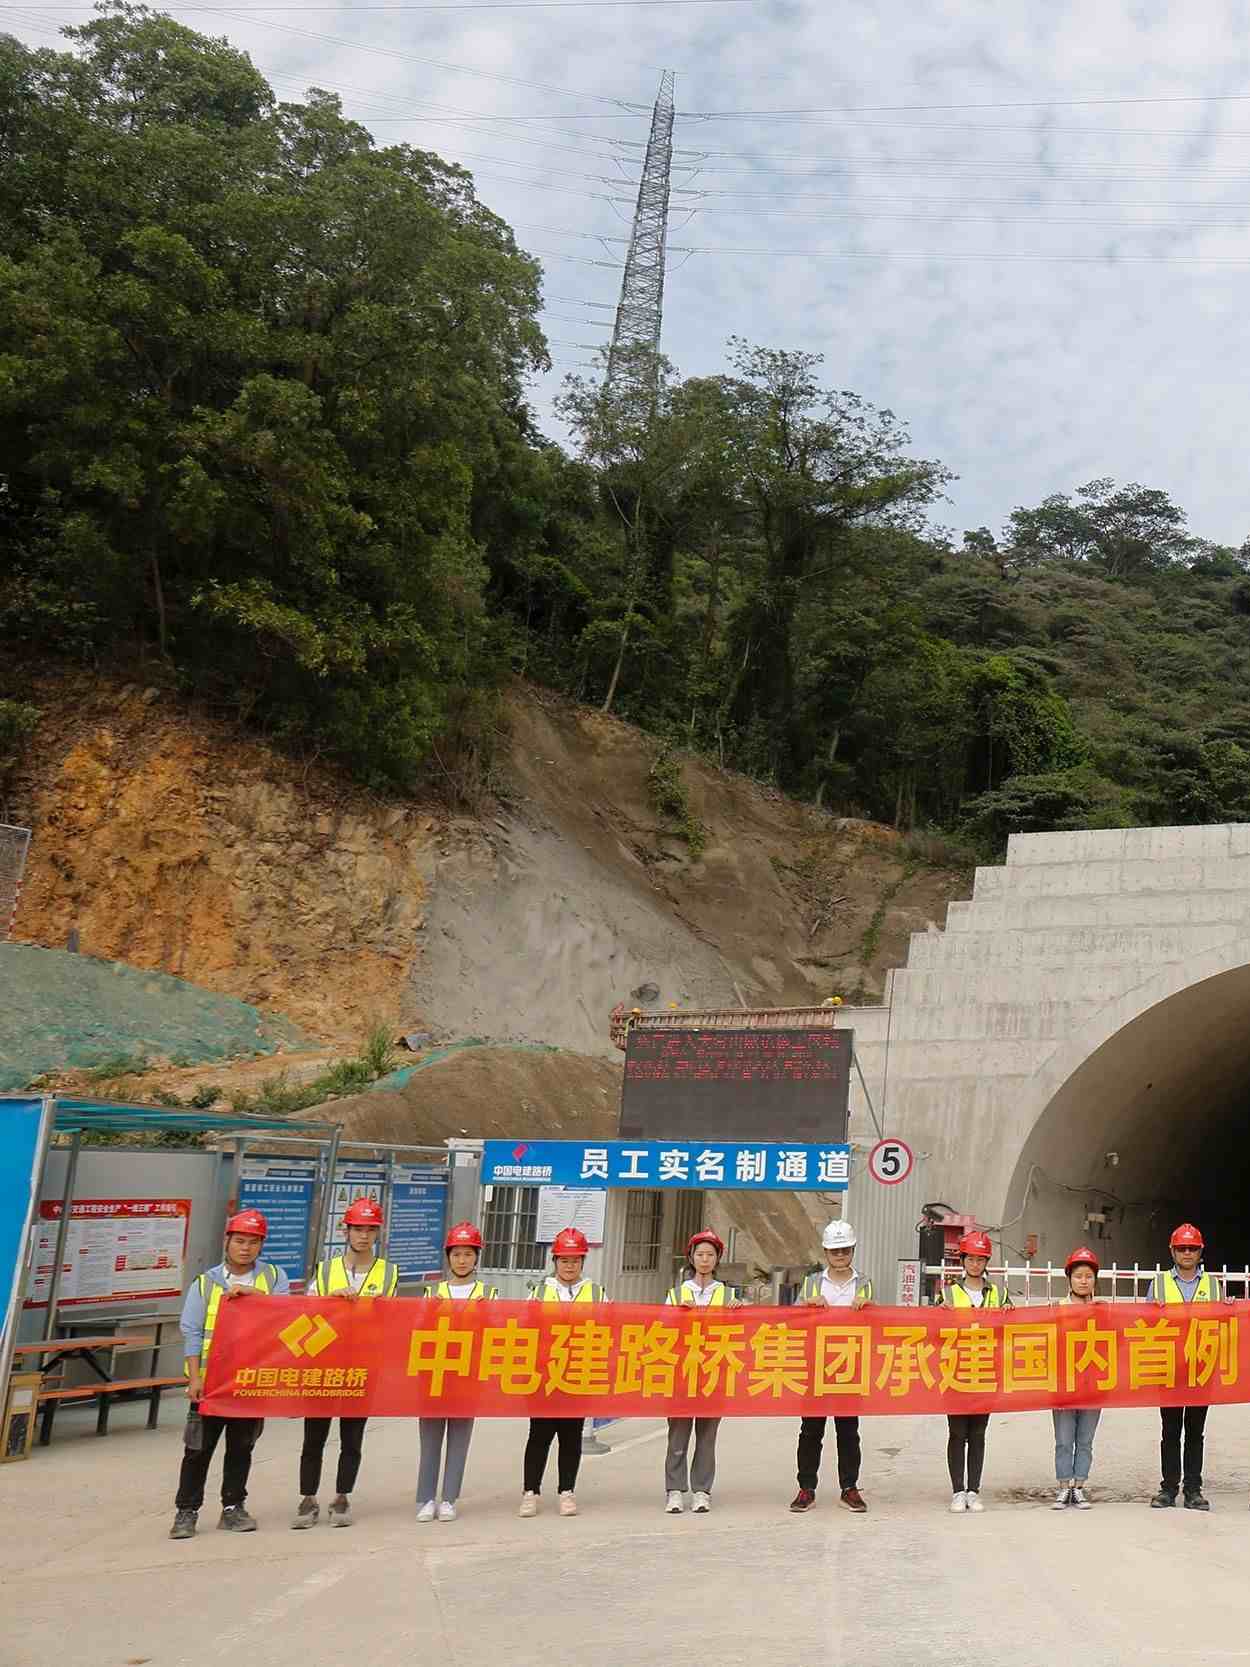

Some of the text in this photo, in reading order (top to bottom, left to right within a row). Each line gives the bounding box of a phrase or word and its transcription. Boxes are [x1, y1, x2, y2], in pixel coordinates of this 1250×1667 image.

[493, 1165, 552, 1177] 中国电建路桥
[580, 1148, 850, 1183] 员工实名制通道
[882, 1147, 900, 1176] 5
[236, 1368, 368, 1387] 中国电建路桥
[233, 1388, 366, 1398] POWERCHINA ROADBRIDGE
